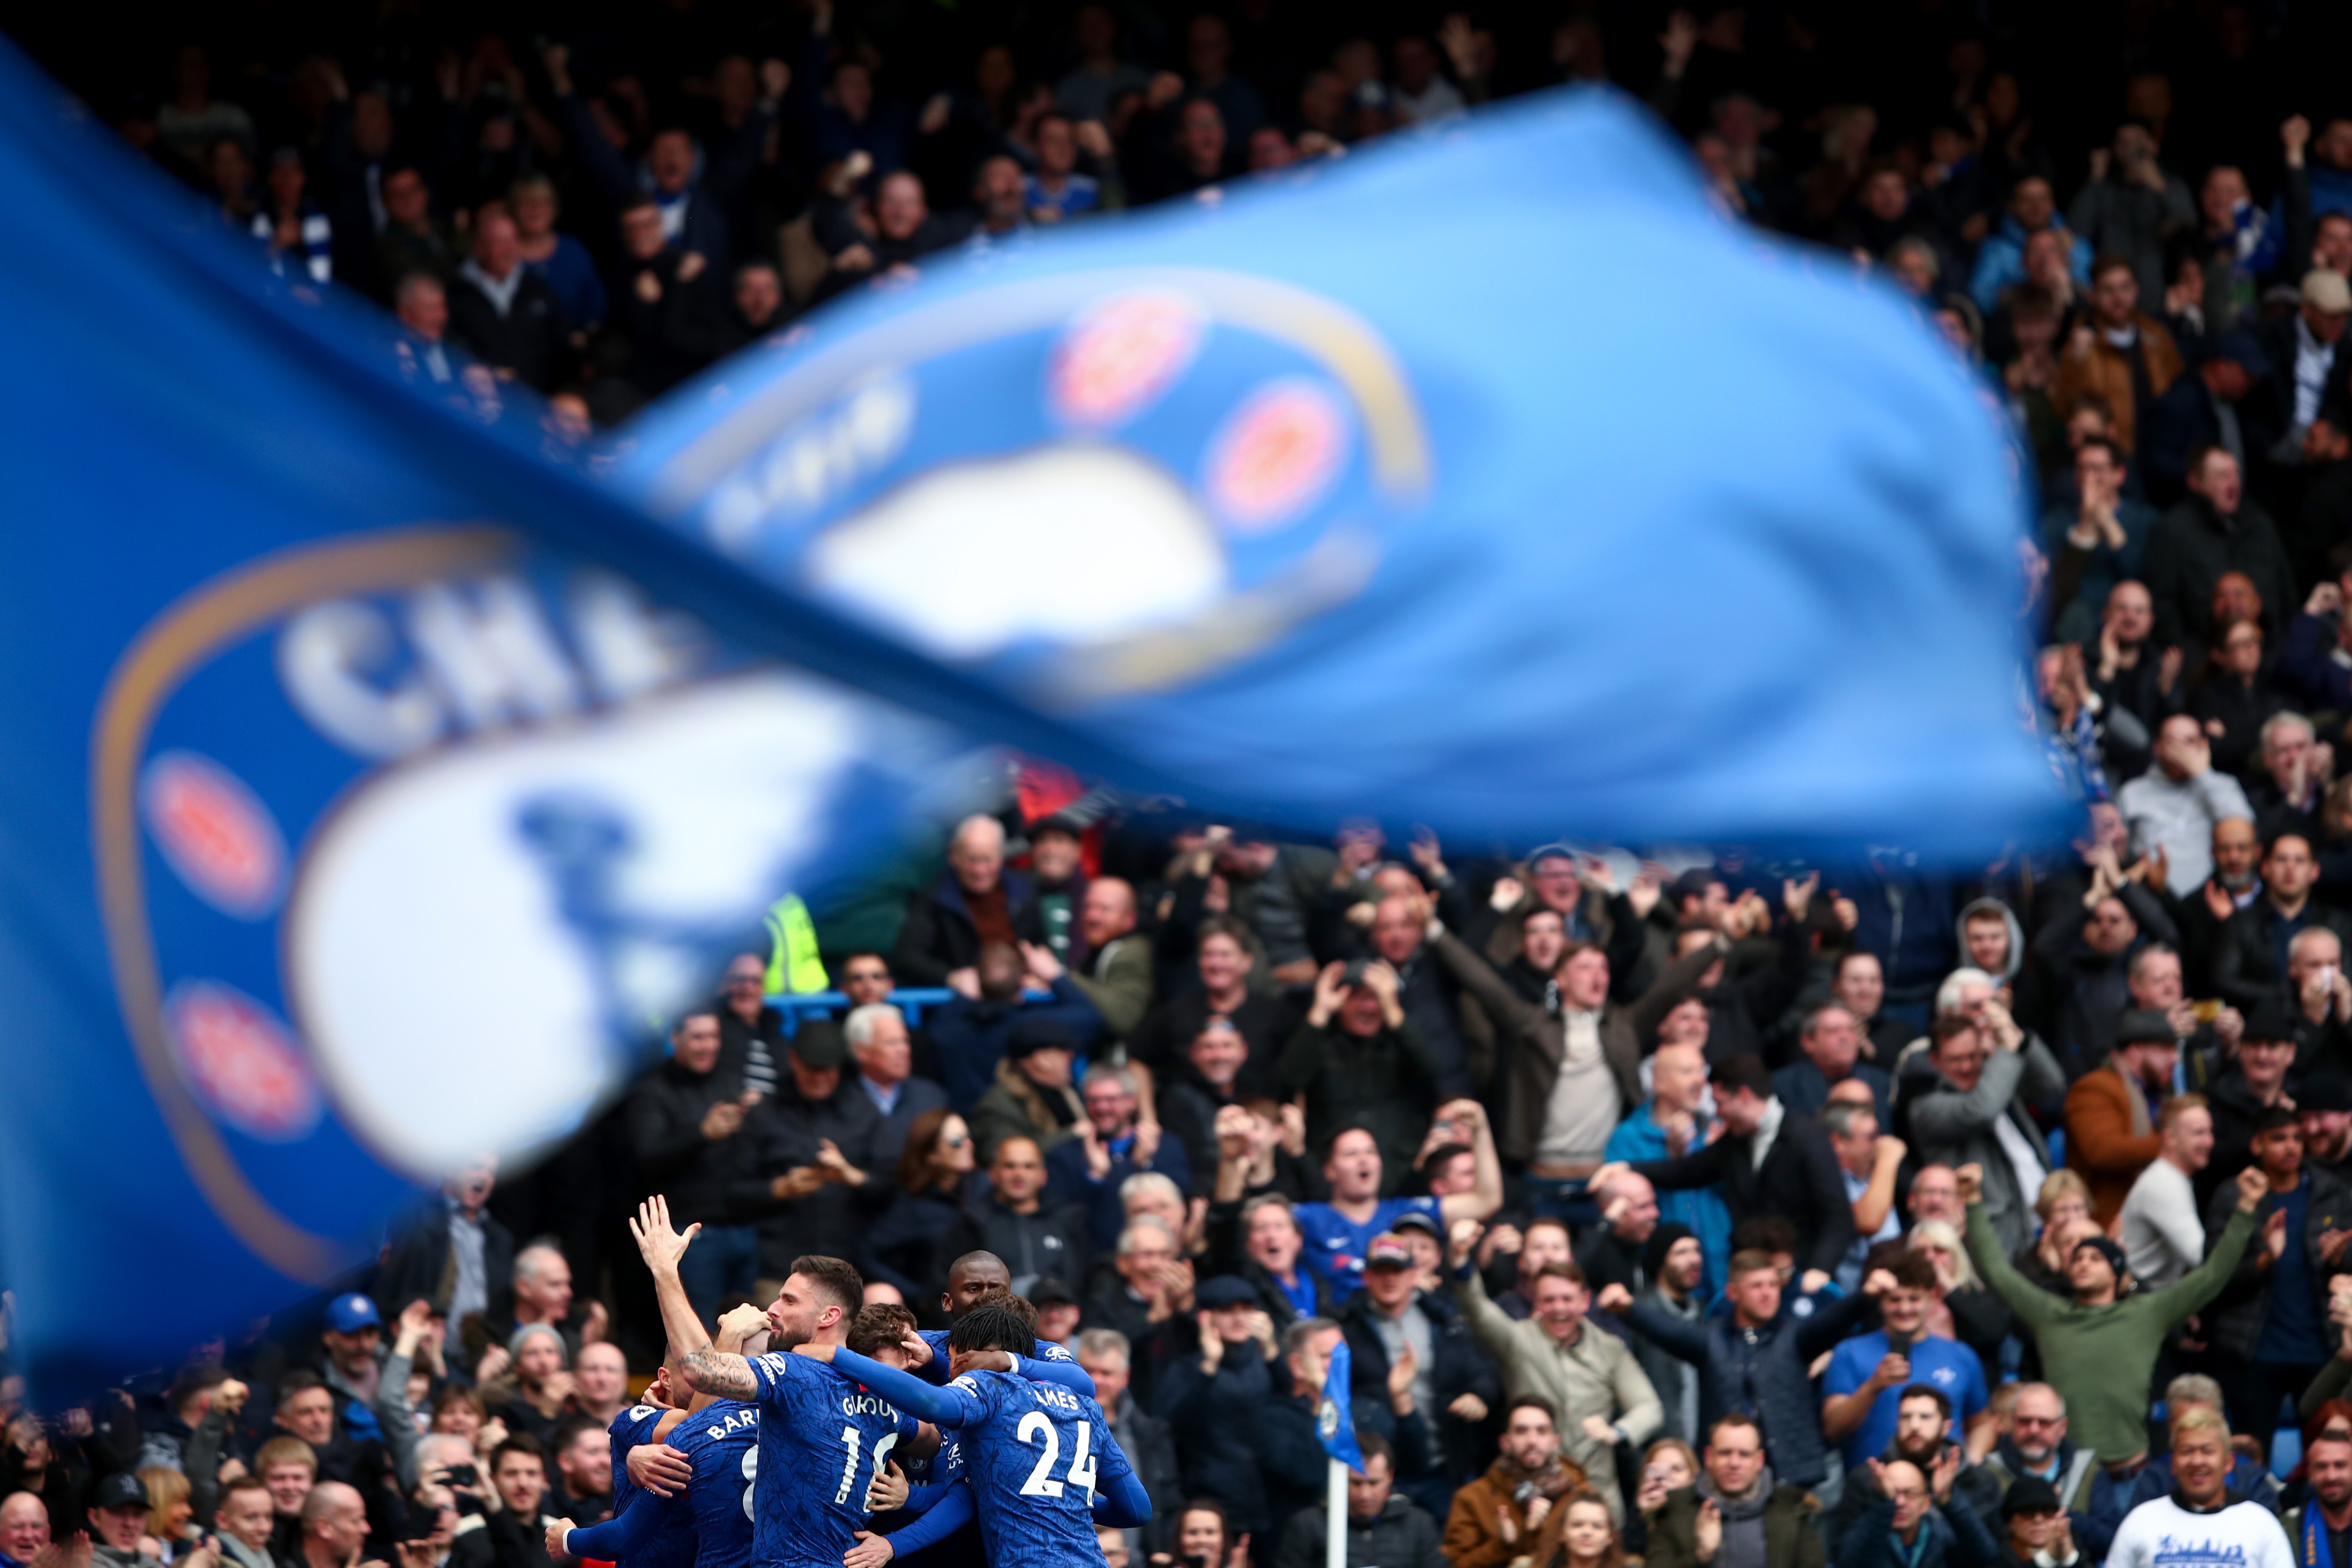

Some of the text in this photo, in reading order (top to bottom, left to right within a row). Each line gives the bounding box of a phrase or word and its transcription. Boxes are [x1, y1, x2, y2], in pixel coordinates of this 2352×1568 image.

[1028, 1388, 1078, 1410] AMES
[707, 1409, 760, 1440] BAR
[1017, 1411, 1096, 1507] 24
